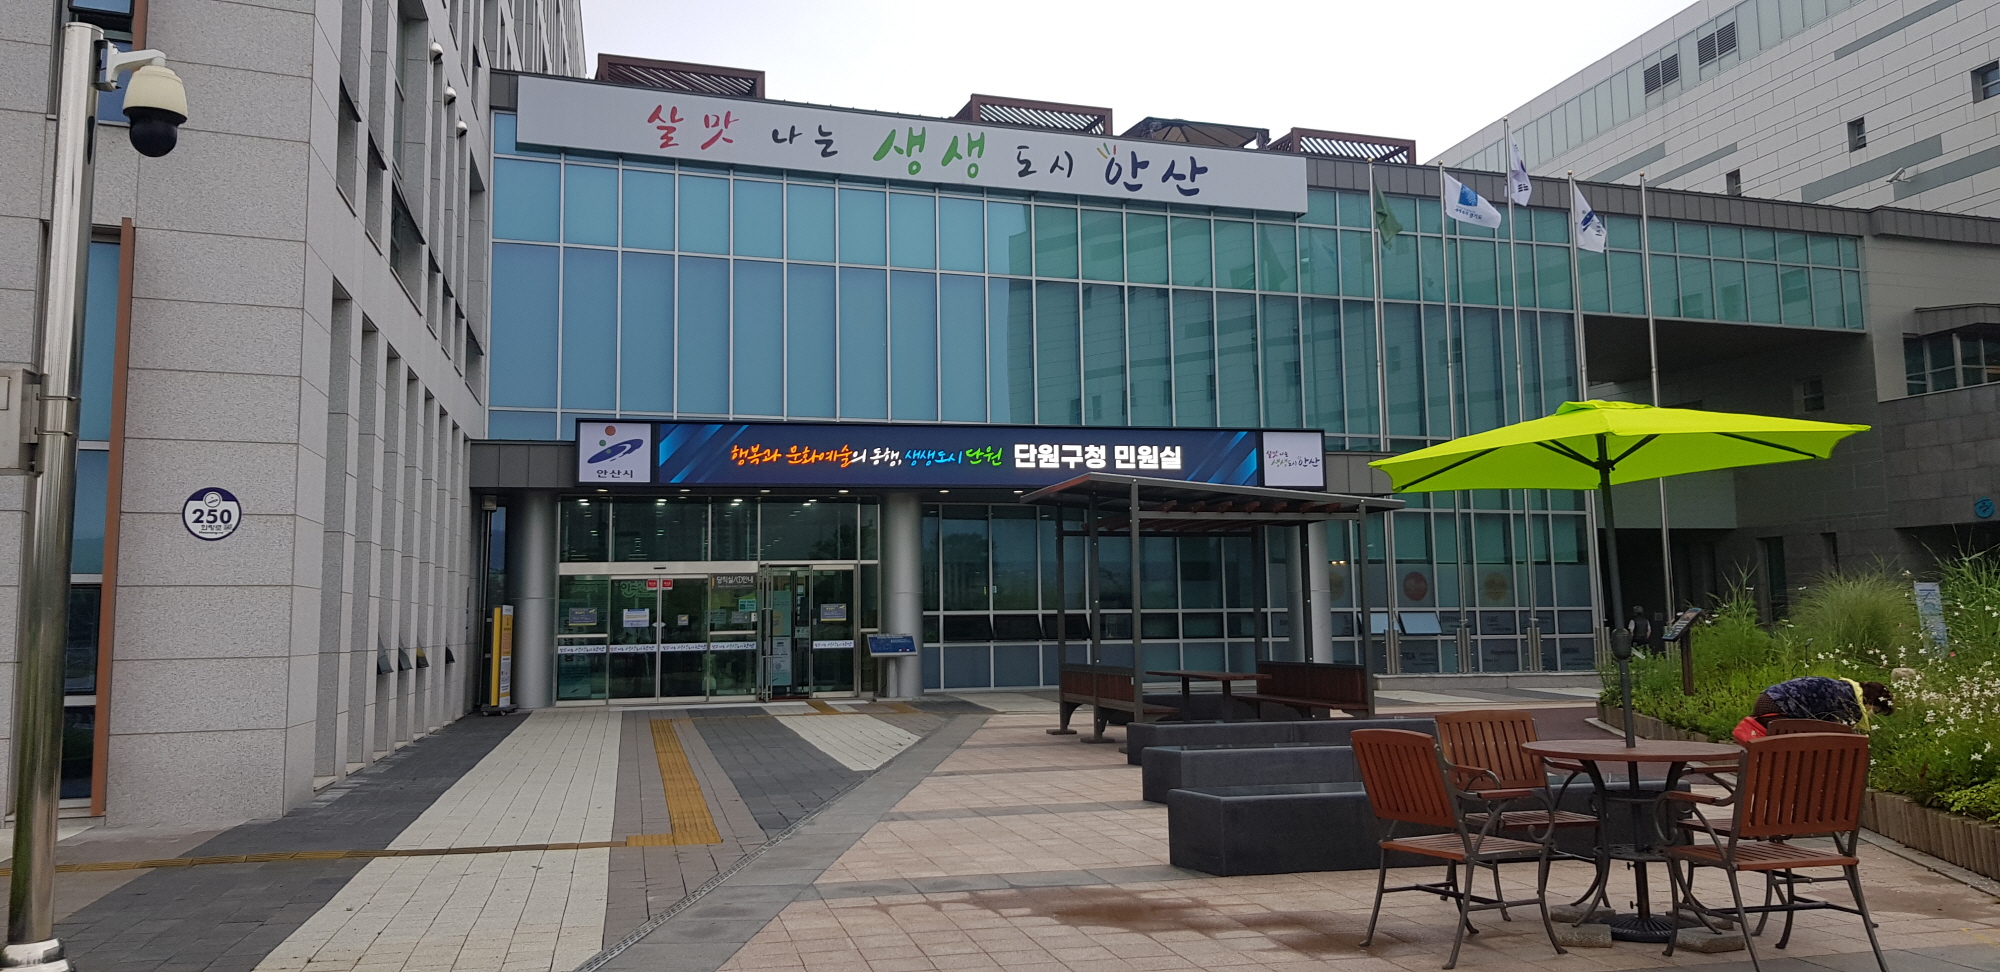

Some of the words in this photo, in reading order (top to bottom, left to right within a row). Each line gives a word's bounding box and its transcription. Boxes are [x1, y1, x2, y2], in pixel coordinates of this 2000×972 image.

[731, 444, 782, 466] 행복과
[785, 444, 867, 468] 문화예술의
[869, 446, 902, 467] 동행,
[904, 449, 963, 467] 생생도시
[965, 445, 1003, 467] 단원
[1014, 444, 1107, 469] 단원구청
[1114, 445, 1182, 470] 민원실
[596, 469, 633, 479] 안산시
[191, 508, 232, 524] 250
